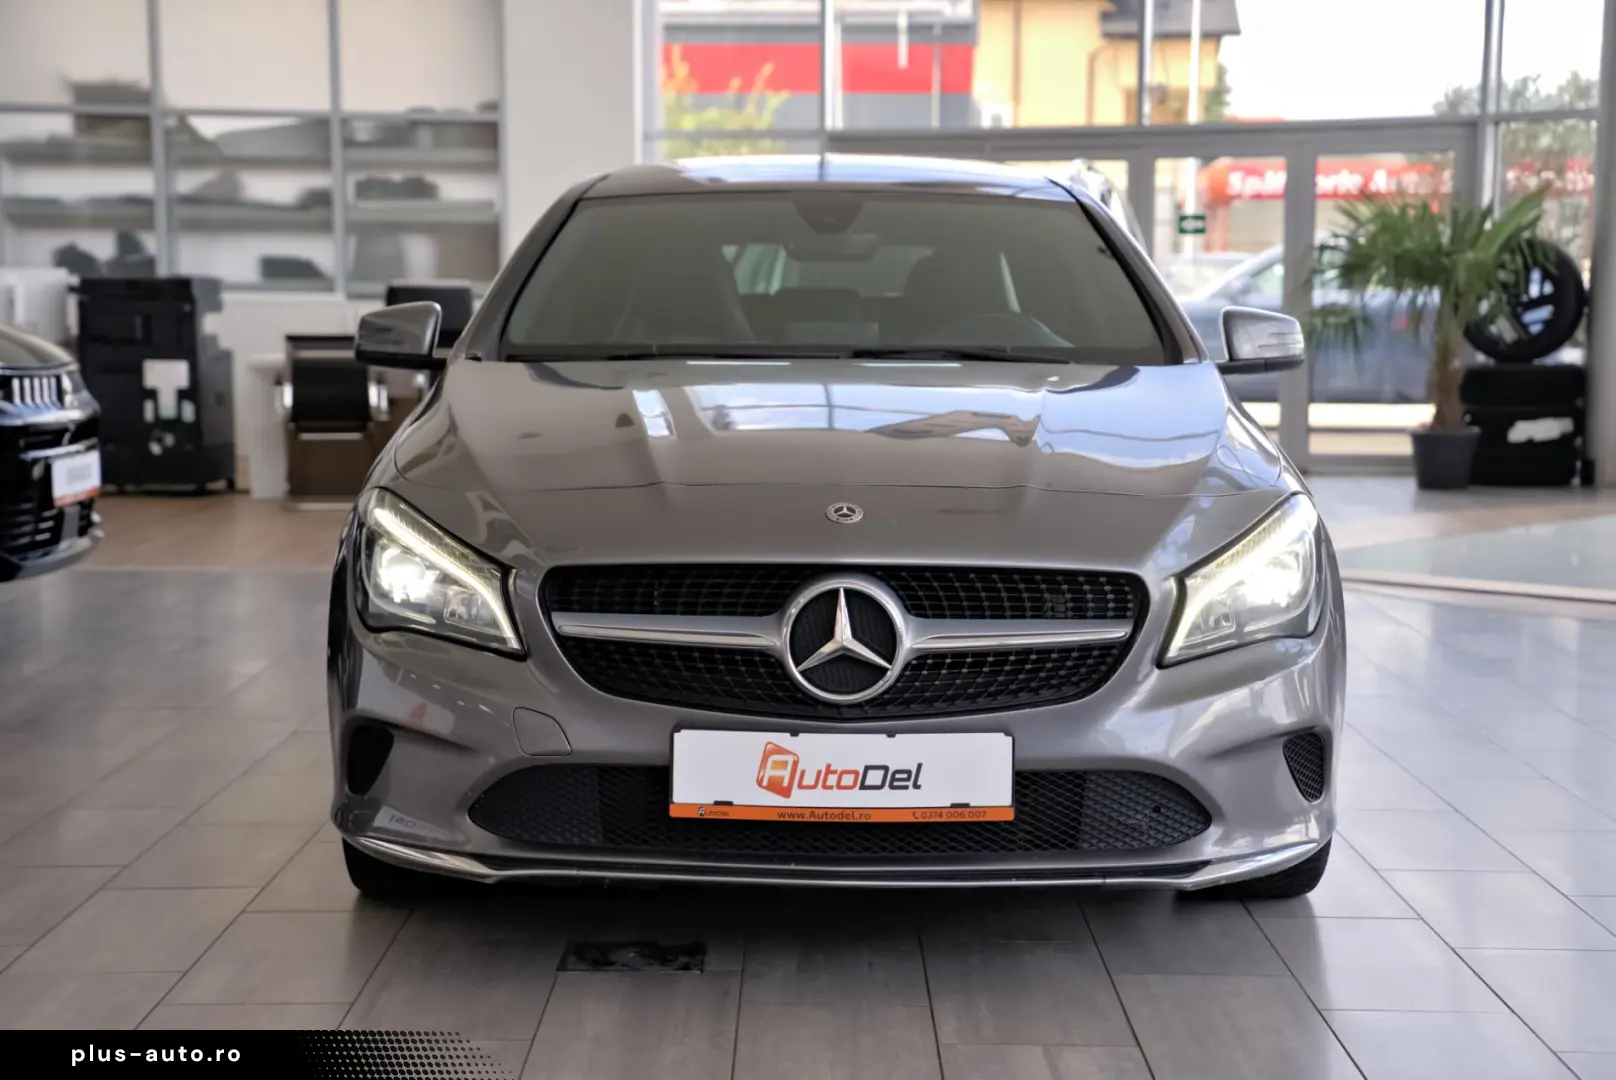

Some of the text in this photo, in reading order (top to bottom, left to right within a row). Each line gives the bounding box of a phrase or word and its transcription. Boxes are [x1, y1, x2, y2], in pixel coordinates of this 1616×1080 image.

[757, 742, 923, 798] AutoDel
[777, 810, 872, 821] www.Autodel.ro
[920, 809, 987, 820] 0374 006 007
